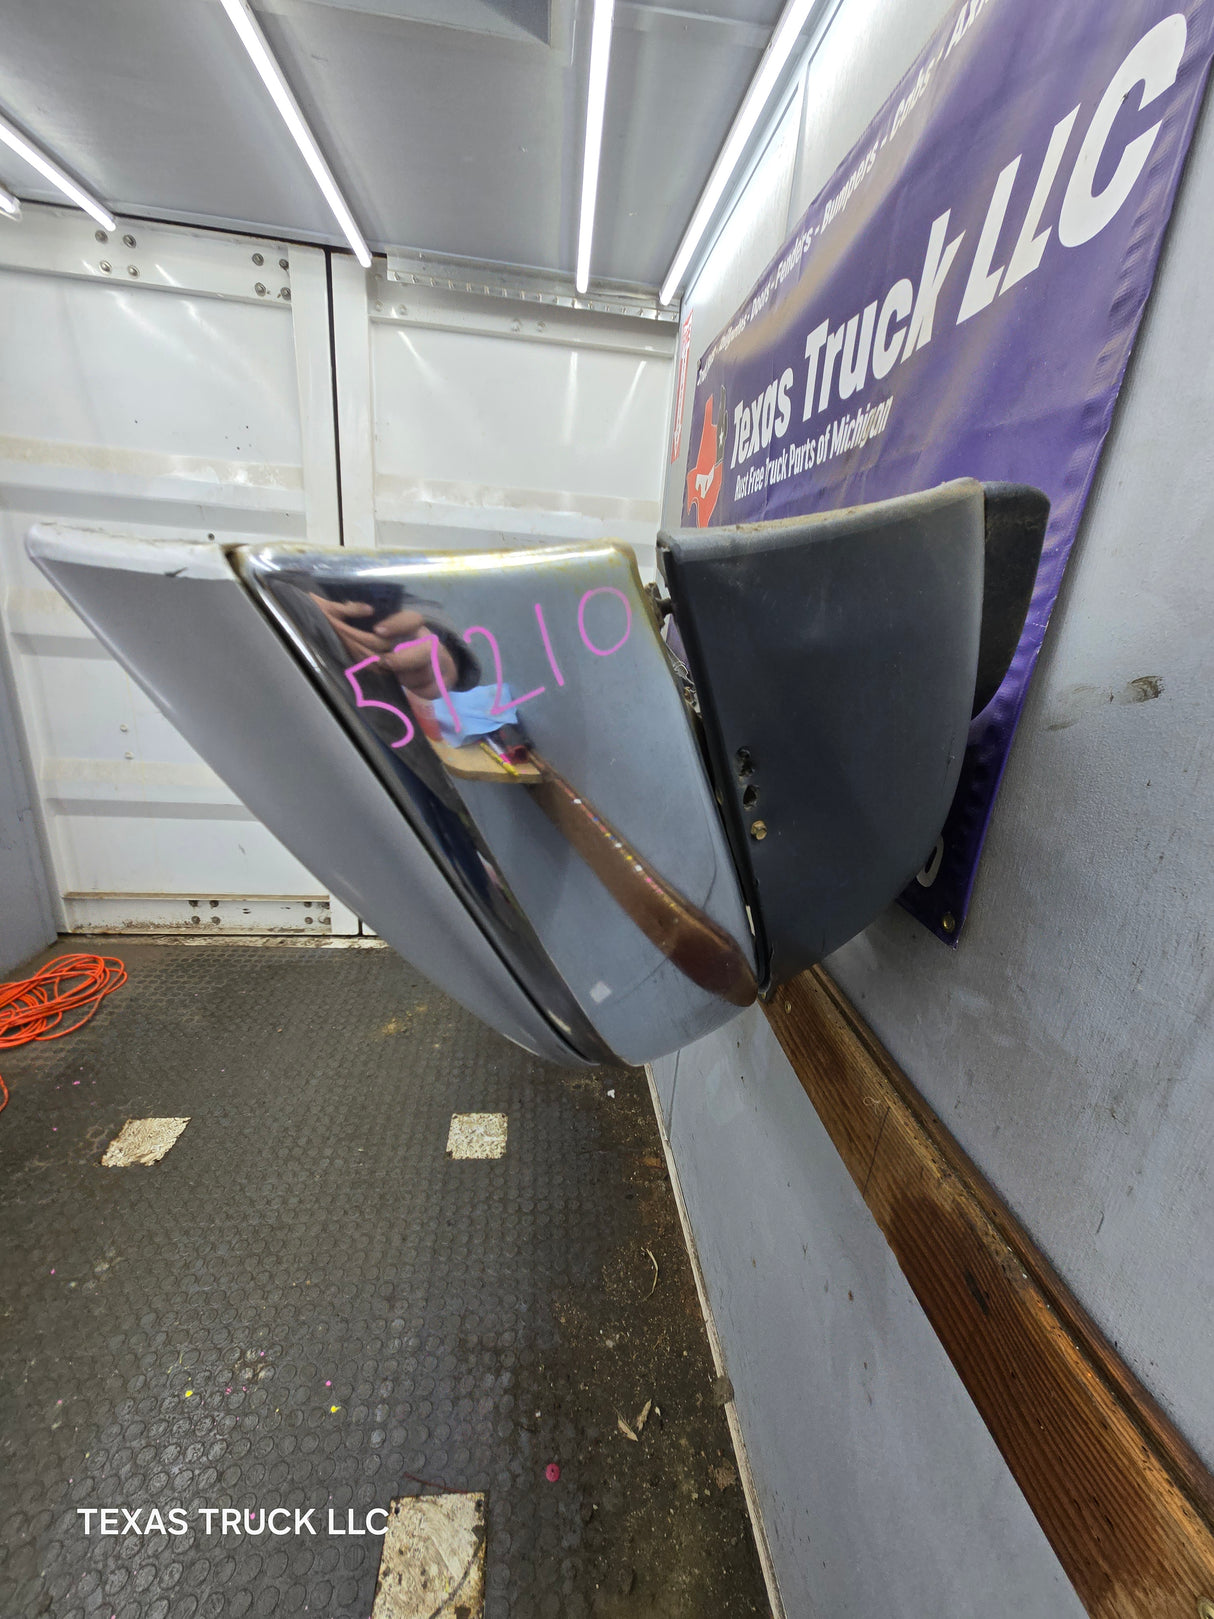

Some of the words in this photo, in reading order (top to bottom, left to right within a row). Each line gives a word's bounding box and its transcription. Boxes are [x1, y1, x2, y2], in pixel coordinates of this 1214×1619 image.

[730, 367, 794, 470] Texas
[802, 208, 966, 422] Truck
[956, 13, 1188, 326] LLC
[775, 227, 814, 289] Fenders
[820, 140, 879, 234] Bumpers
[889, 57, 935, 141] Cabs
[734, 472, 750, 502] Rust
[748, 462, 765, 496] Free
[764, 448, 788, 488] Truck
[788, 438, 816, 477] Parts
[816, 424, 832, 465] of
[829, 395, 894, 460] Michigan
[345, 586, 632, 748] 57210
